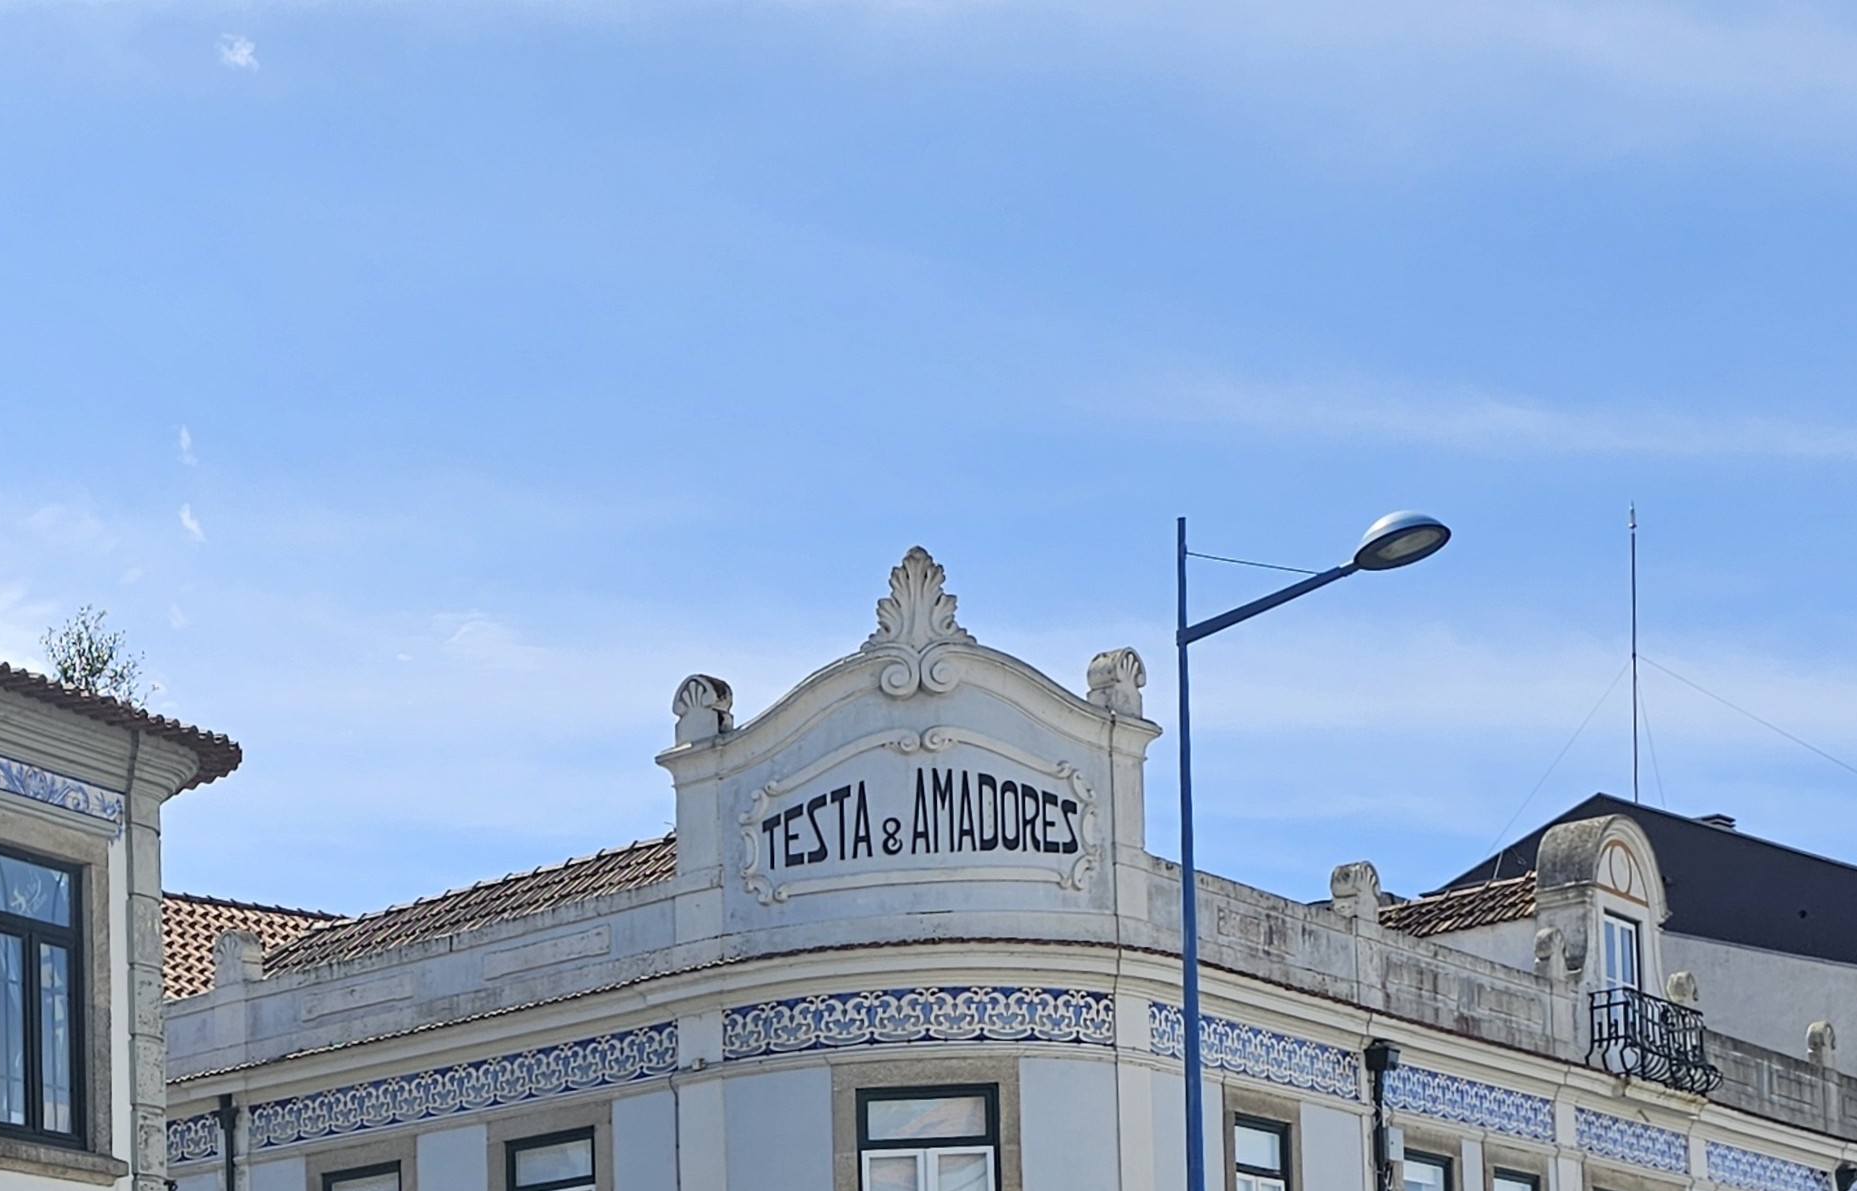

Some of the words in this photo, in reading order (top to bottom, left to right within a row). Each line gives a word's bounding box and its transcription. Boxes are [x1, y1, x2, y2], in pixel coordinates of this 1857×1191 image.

[762, 780, 873, 870] TESTA
[882, 817, 903, 856] &
[911, 767, 1079, 855] AMADORES
